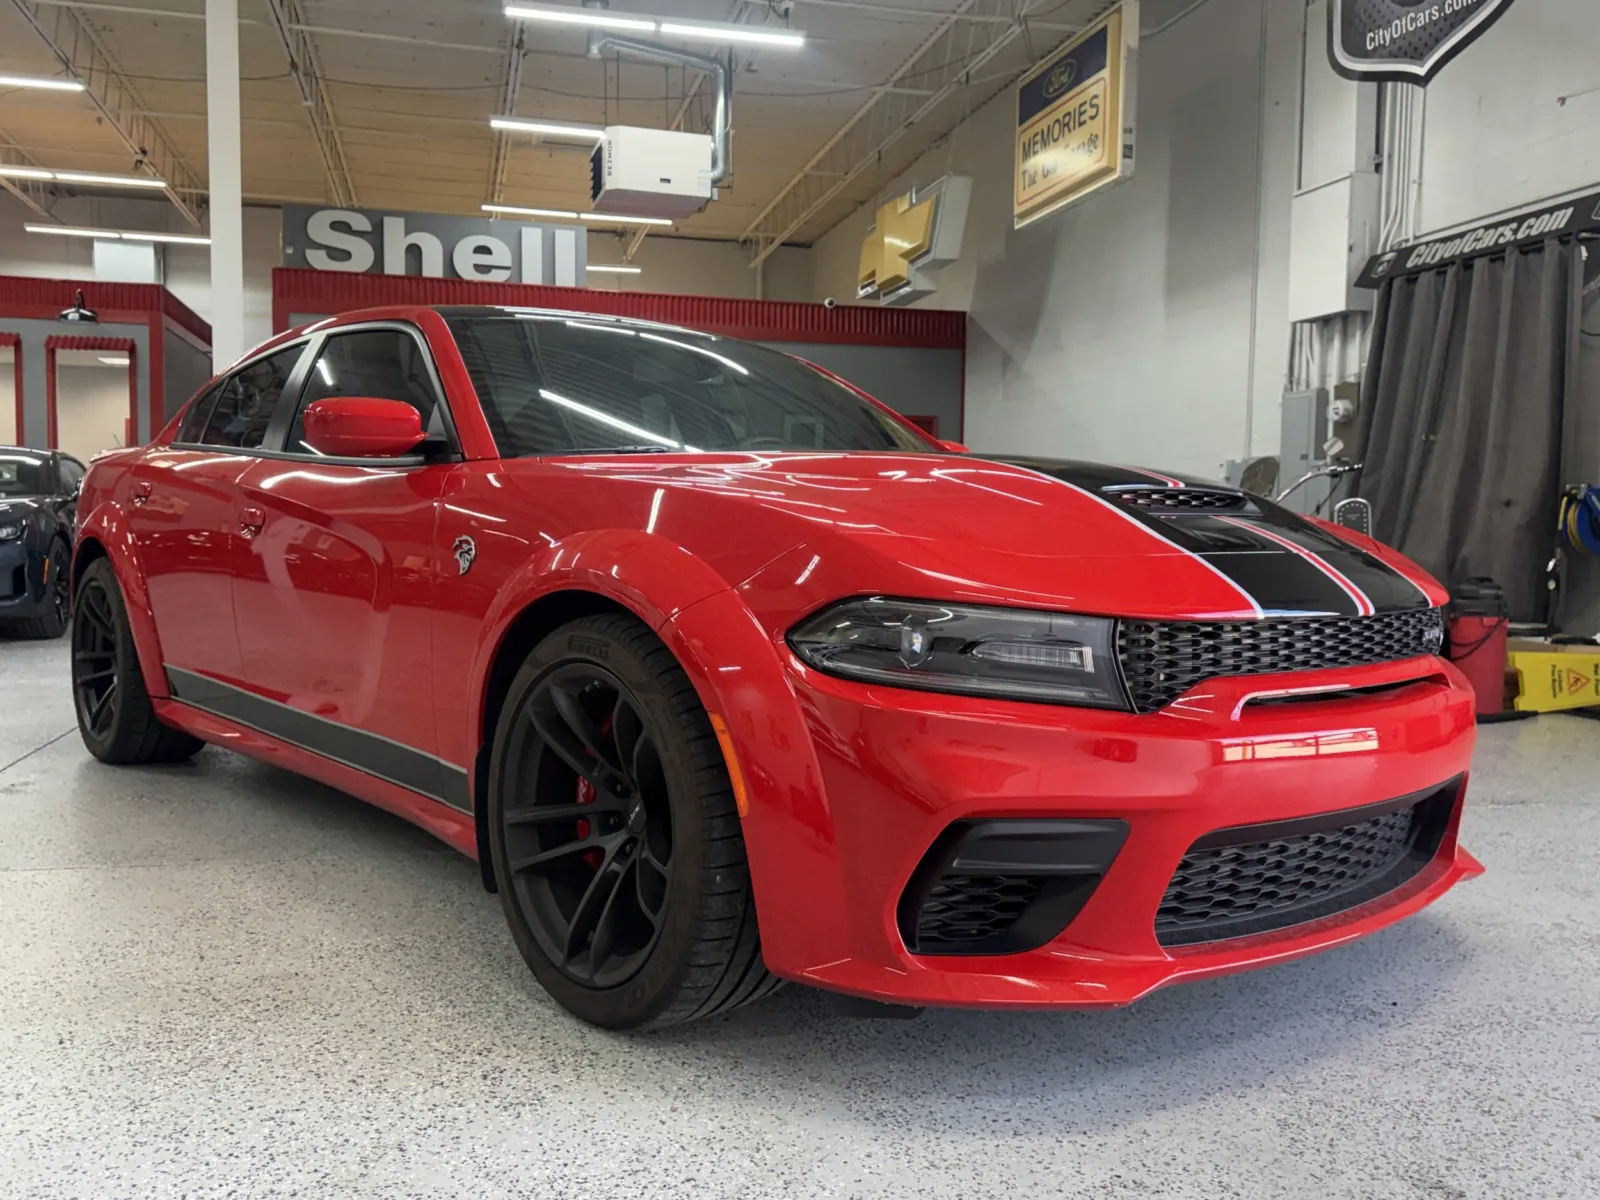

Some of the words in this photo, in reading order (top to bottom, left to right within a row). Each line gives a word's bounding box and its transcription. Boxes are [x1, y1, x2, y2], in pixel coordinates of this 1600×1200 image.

[1021, 94, 1100, 164] MEMORIES
[304, 208, 576, 288] Shell
[1405, 206, 1574, 268] CityofCars.com
